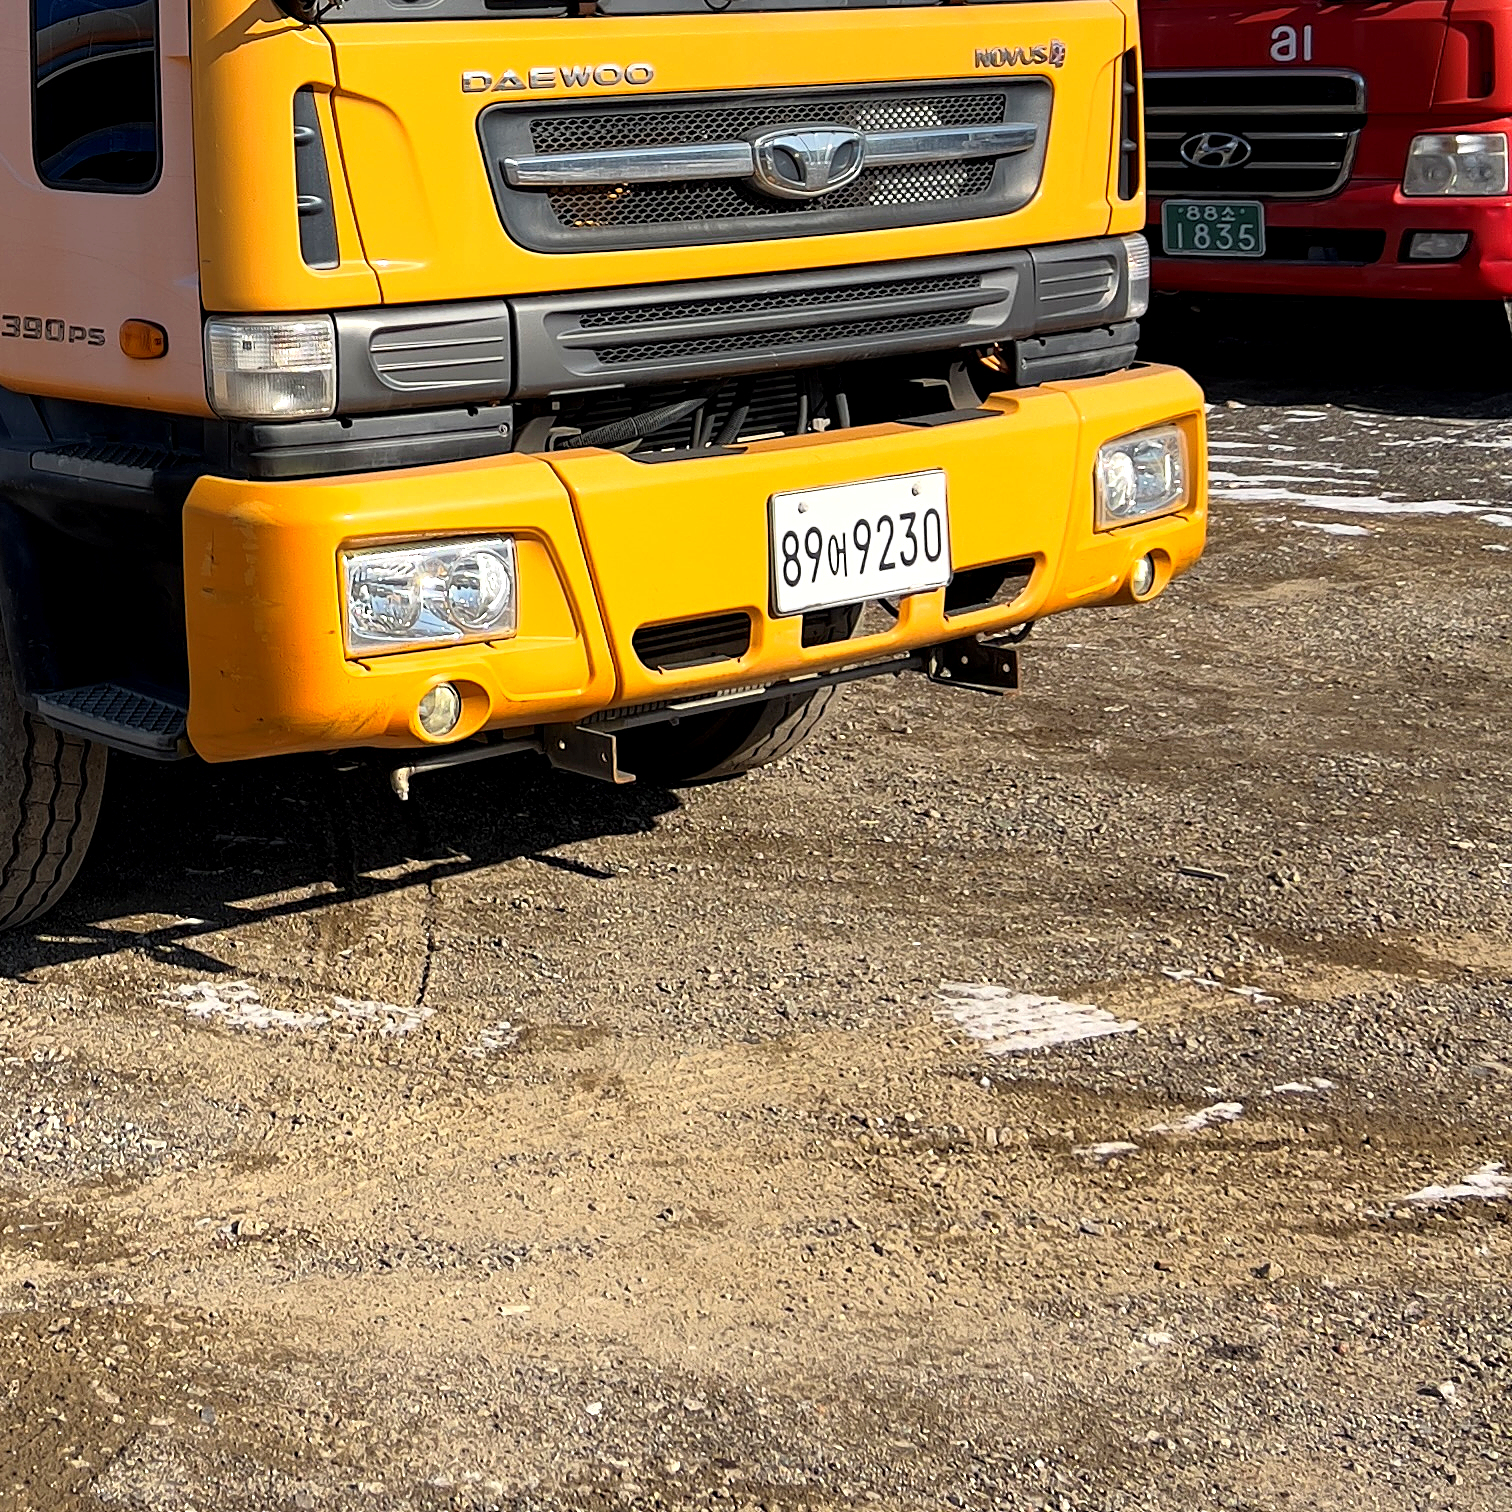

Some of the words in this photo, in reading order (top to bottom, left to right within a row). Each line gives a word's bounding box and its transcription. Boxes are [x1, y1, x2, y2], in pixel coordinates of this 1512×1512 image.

[974, 45, 1049, 68] NOVUS
[461, 63, 654, 93] DAEWOO
[1186, 205, 1236, 222] 88소
[1177, 222, 1256, 250] 1835
[782, 507, 942, 588] 89어9230
